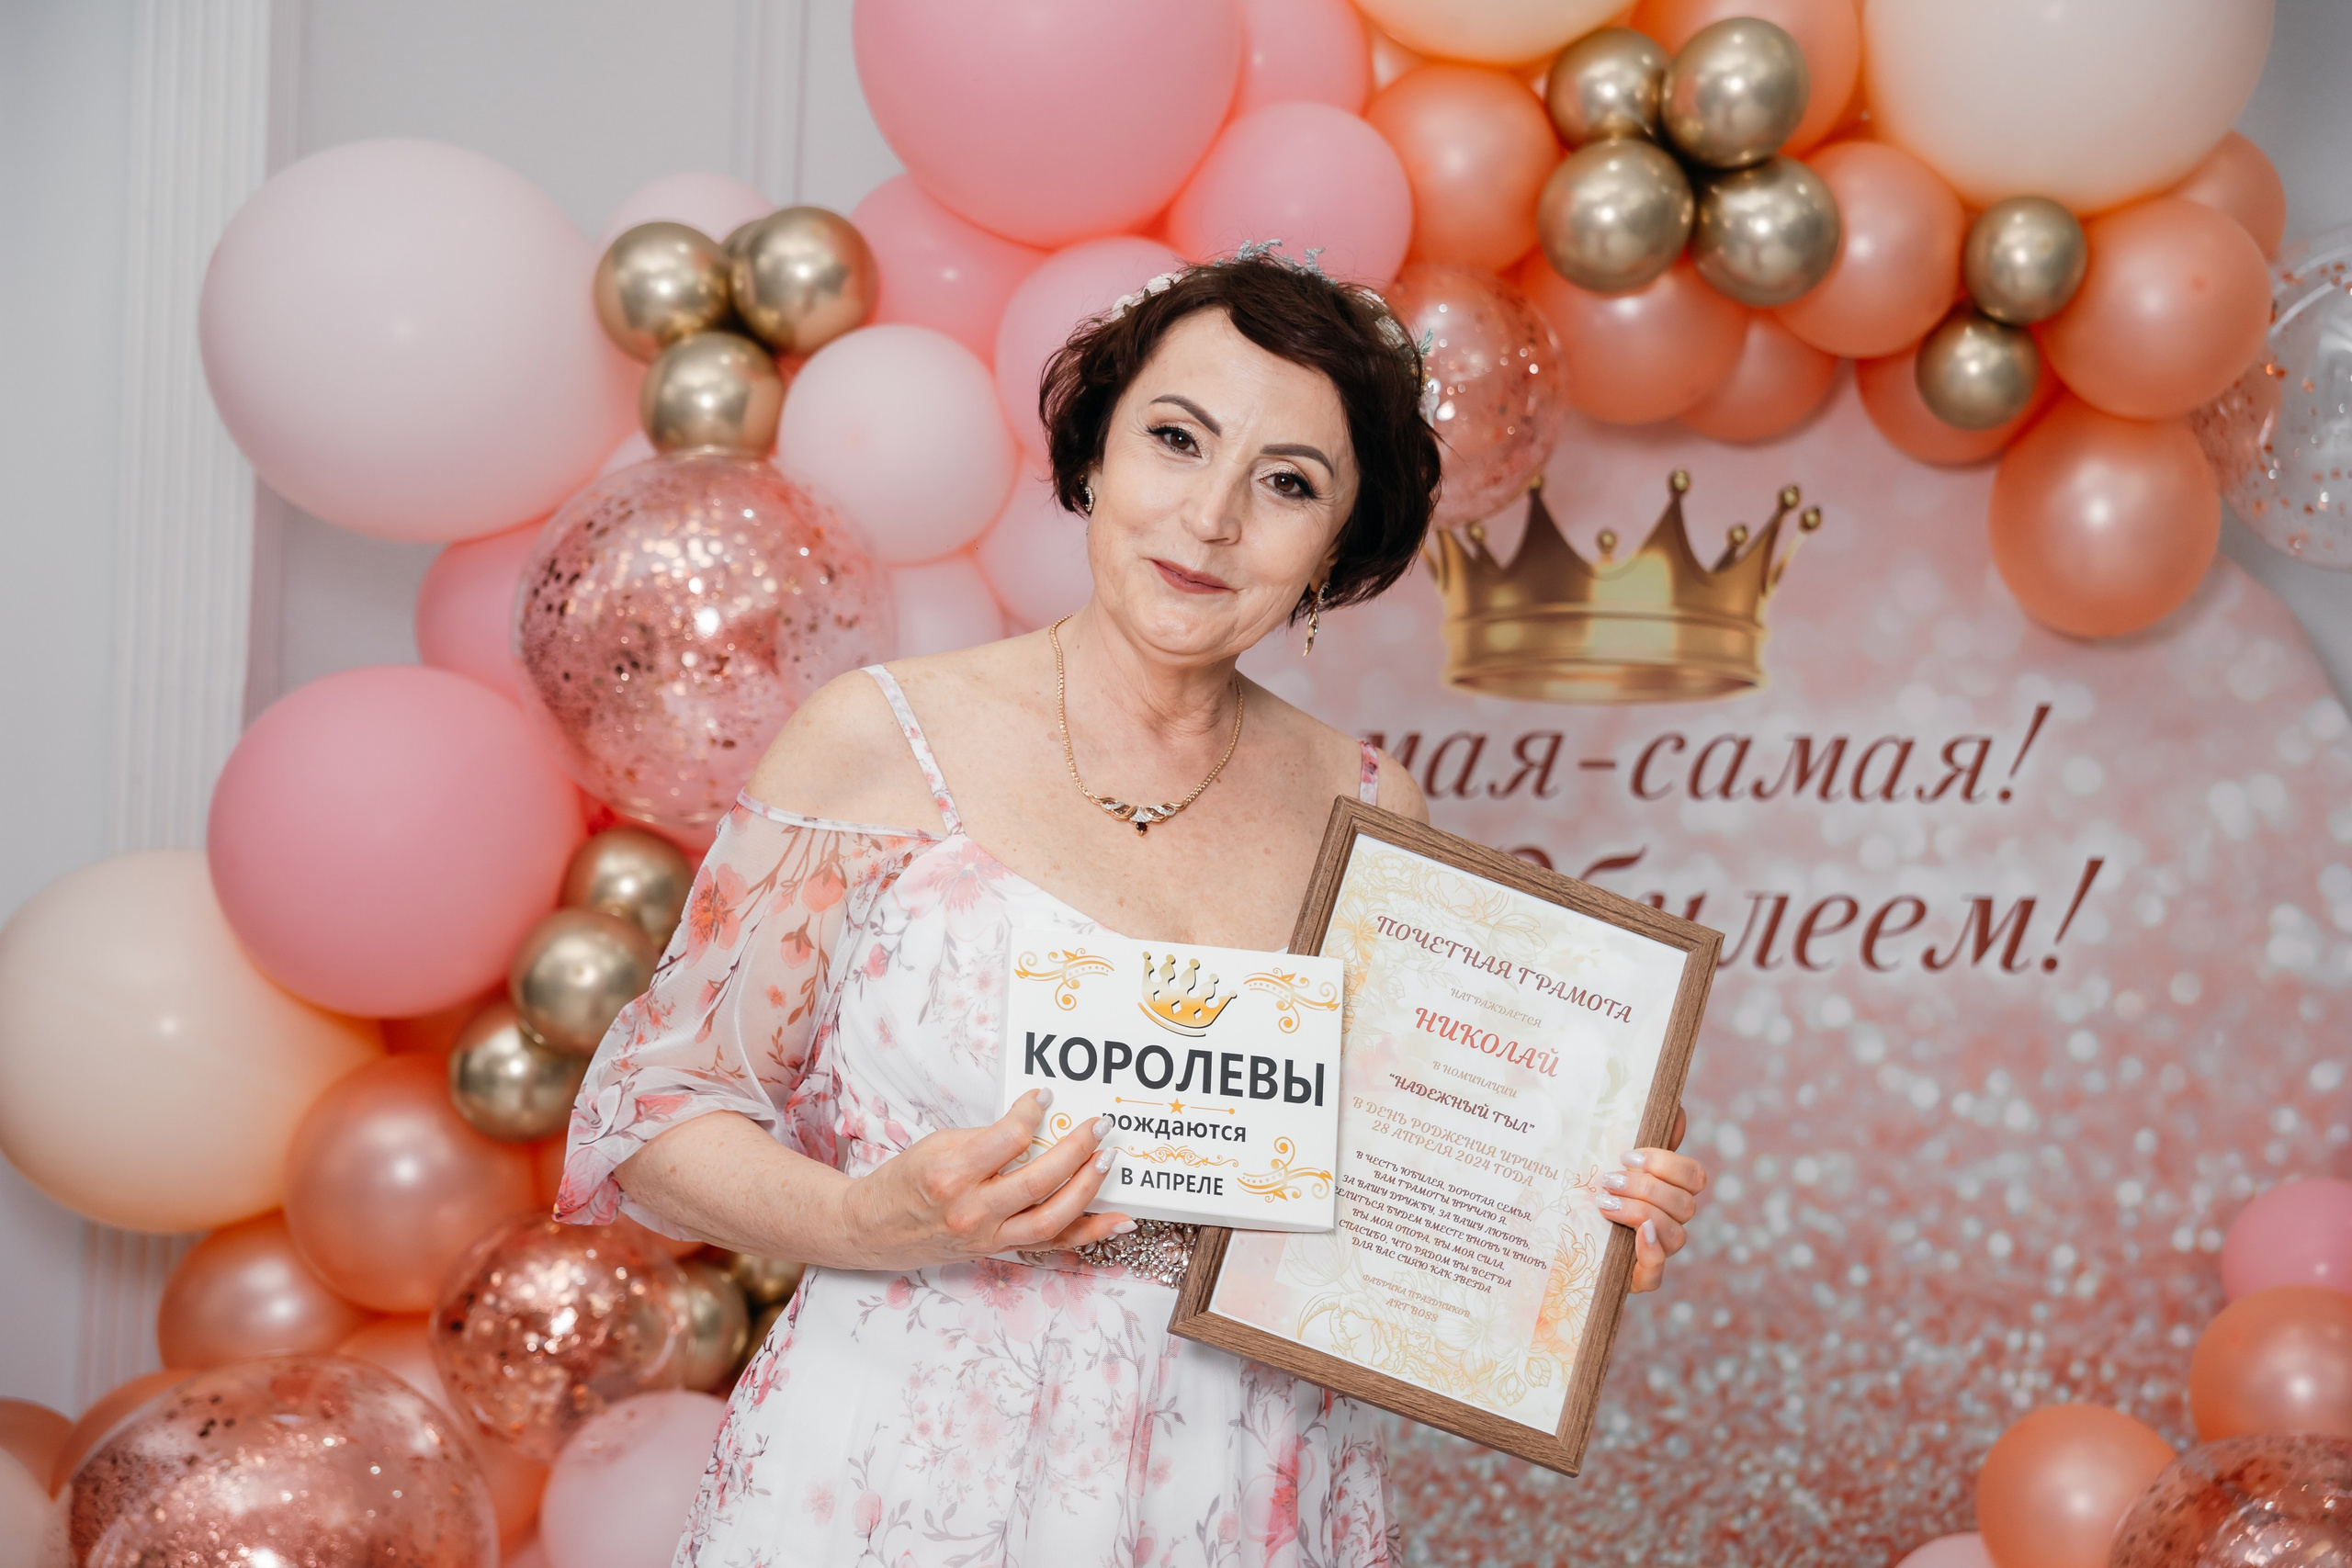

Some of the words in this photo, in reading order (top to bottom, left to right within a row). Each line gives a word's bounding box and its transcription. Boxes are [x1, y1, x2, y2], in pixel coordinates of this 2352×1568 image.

[1504, 843, 2107, 976] леем!
[1377, 916, 1512, 979] ПОЧЕТНАЯ
[1518, 966, 1632, 1023] ГРАМОТА
[1451, 987, 1542, 1028] НАГРАЖДАЕТСЯ
[1024, 1031, 1326, 1108] КОРОЛЕВЫ
[1415, 1007, 1559, 1077] НИКОЛАЙ
[1432, 1060, 1442, 1071] В
[1442, 1064, 1518, 1099] НОМИНАЦИИ
[1352, 1096, 1363, 1109] В
[1365, 1101, 1408, 1125] ДЕНЬ
[1410, 1117, 1498, 1158] РОДЖЕНИЯ
[1499, 1149, 1558, 1180] ИРИНЫ
[1371, 1120, 1390, 1134] 28
[1390, 1127, 1453, 1158] АПРЕЛЯ
[1454, 1149, 1491, 1171] 2024
[1493, 1163, 1533, 1187] ГОДА
[1120, 1167, 1134, 1185] В
[1139, 1169, 1225, 1196] АПРЕЛЕ
[1341, 1174, 1356, 1186] ЗА
[1357, 1179, 1389, 1197] ВАШУ
[1437, 1209, 1452, 1220] ЗА
[1453, 1213, 1485, 1232] ВАШУ
[1356, 1150, 1364, 1160] В
[1365, 1154, 1398, 1172] ЧЕСТЬ
[1400, 1166, 1445, 1190] ЮБИЛЕЯ,
[1448, 1183, 1495, 1208] ДОРОГАЯ
[1496, 1201, 1532, 1223] СЕМЬЯ,
[1374, 1169, 1396, 1185] ВАМ
[1397, 1179, 1451, 1205] ГРАМОТЫ
[1452, 1198, 1498, 1221] ВРУЧАЮ
[1338, 1219, 1388, 1245] СПАСИБО,
[1391, 1236, 1413, 1251] ЧТО
[1414, 1246, 1451, 1266] РЯДОМ
[1452, 1258, 1470, 1272] ВЫ
[1471, 1266, 1512, 1288] ВСЕГДА
[1351, 1236, 1374, 1251] ДЛЯ
[1374, 1245, 1396, 1259] ВАС
[1396, 1253, 1429, 1270] СИЯЮ
[1430, 1264, 1453, 1280] КАК
[1452, 1273, 1492, 1294] ЗВЕЗДА
[1352, 1207, 1370, 1221] ВЫ
[1369, 1215, 1394, 1230] МОЯ
[1395, 1224, 1430, 1245] ОПОРА,
[1433, 1236, 1452, 1250] ВЫ
[1451, 1245, 1476, 1259] МОЯ
[1476, 1253, 1505, 1271] СИЛА,
[1386, 1204, 1423, 1225] БУДЕМ
[1424, 1218, 1464, 1240] ВМЕСТЕ
[1465, 1234, 1500, 1253] ВНОВЬ
[1502, 1247, 1511, 1258] И
[1512, 1250, 1547, 1270] ВНОВЬ
[1362, 1274, 1407, 1296] ФАБРИКА
[1408, 1289, 1471, 1319] ПРАЗДНИКОВ
[1385, 1297, 1411, 1312] ART
[1410, 1304, 1439, 1323] BOSS
